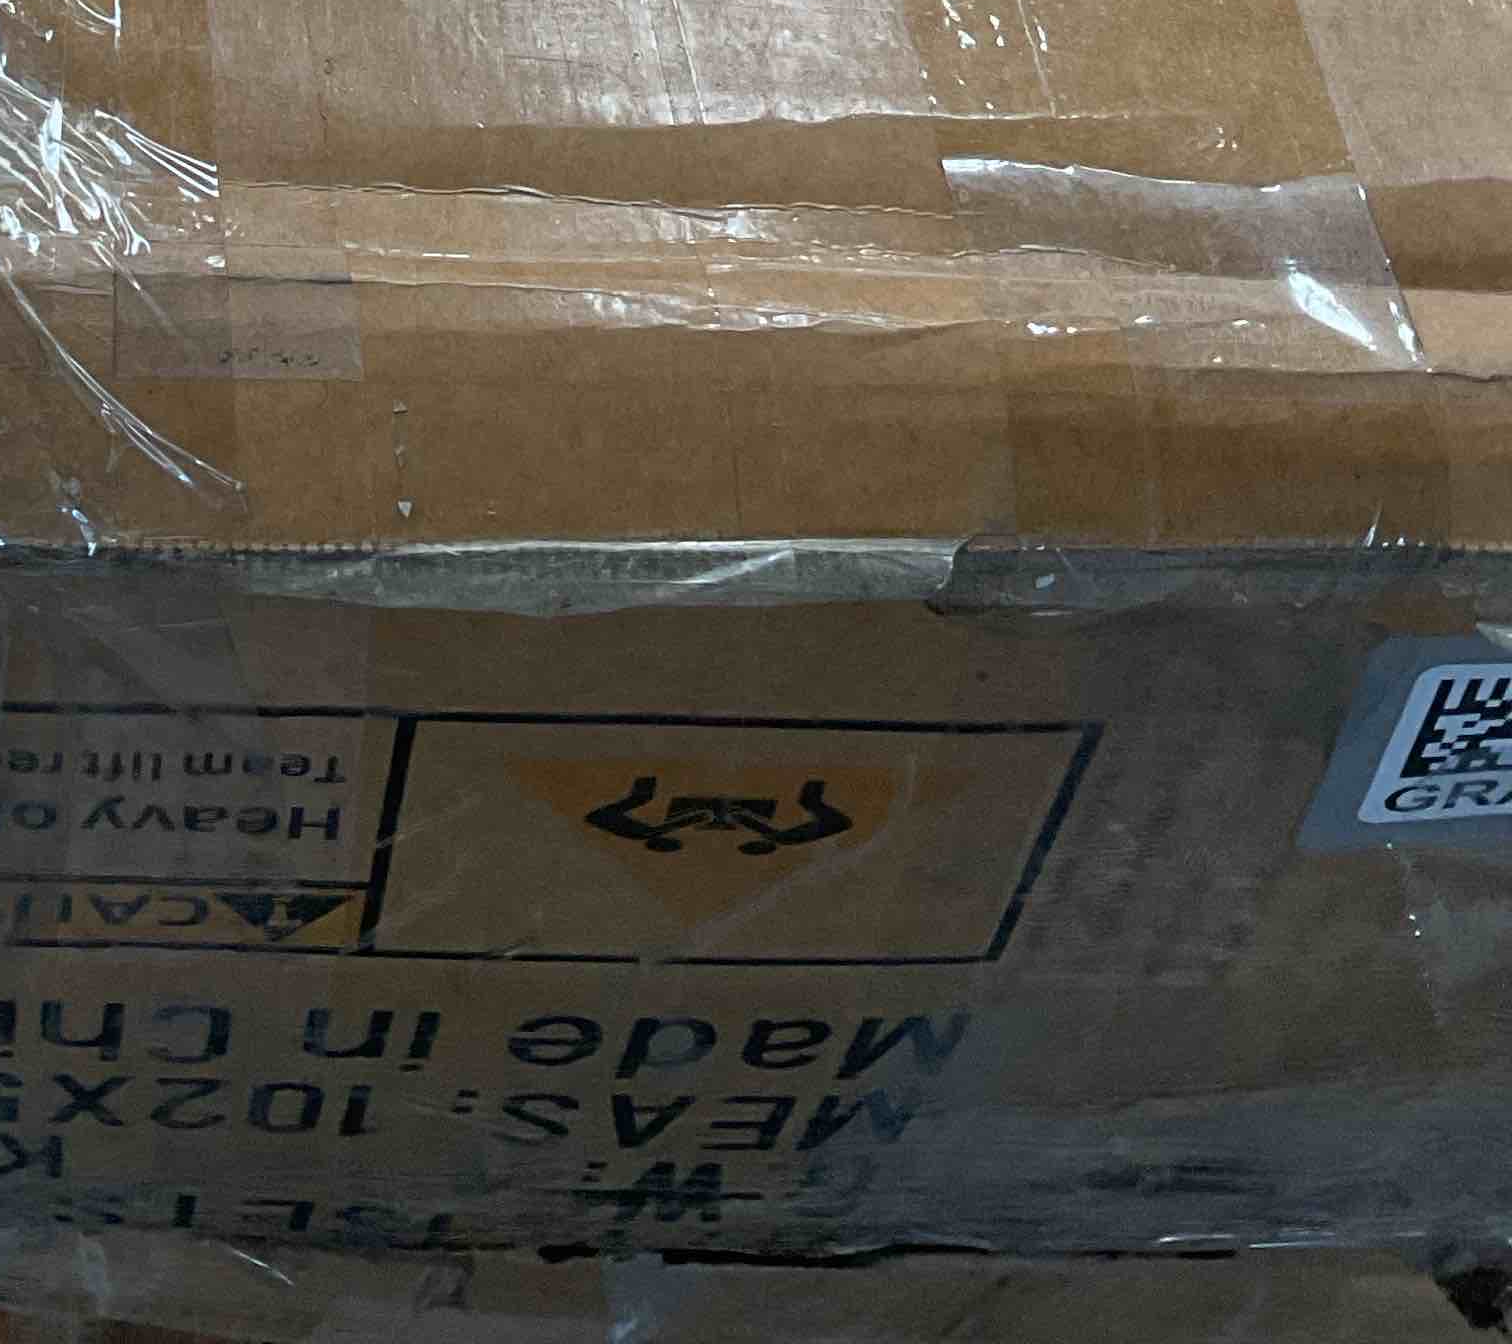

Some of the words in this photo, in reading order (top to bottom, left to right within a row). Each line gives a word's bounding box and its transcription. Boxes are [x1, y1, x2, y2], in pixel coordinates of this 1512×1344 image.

[86, 750, 163, 781] lift
[182, 752, 346, 784] Team
[80, 795, 341, 842] Heavy
[1384, 779, 1512, 813] GR
[303, 1007, 445, 1073] in
[508, 1010, 971, 1081] Made
[454, 1084, 917, 1154] MEAS:
